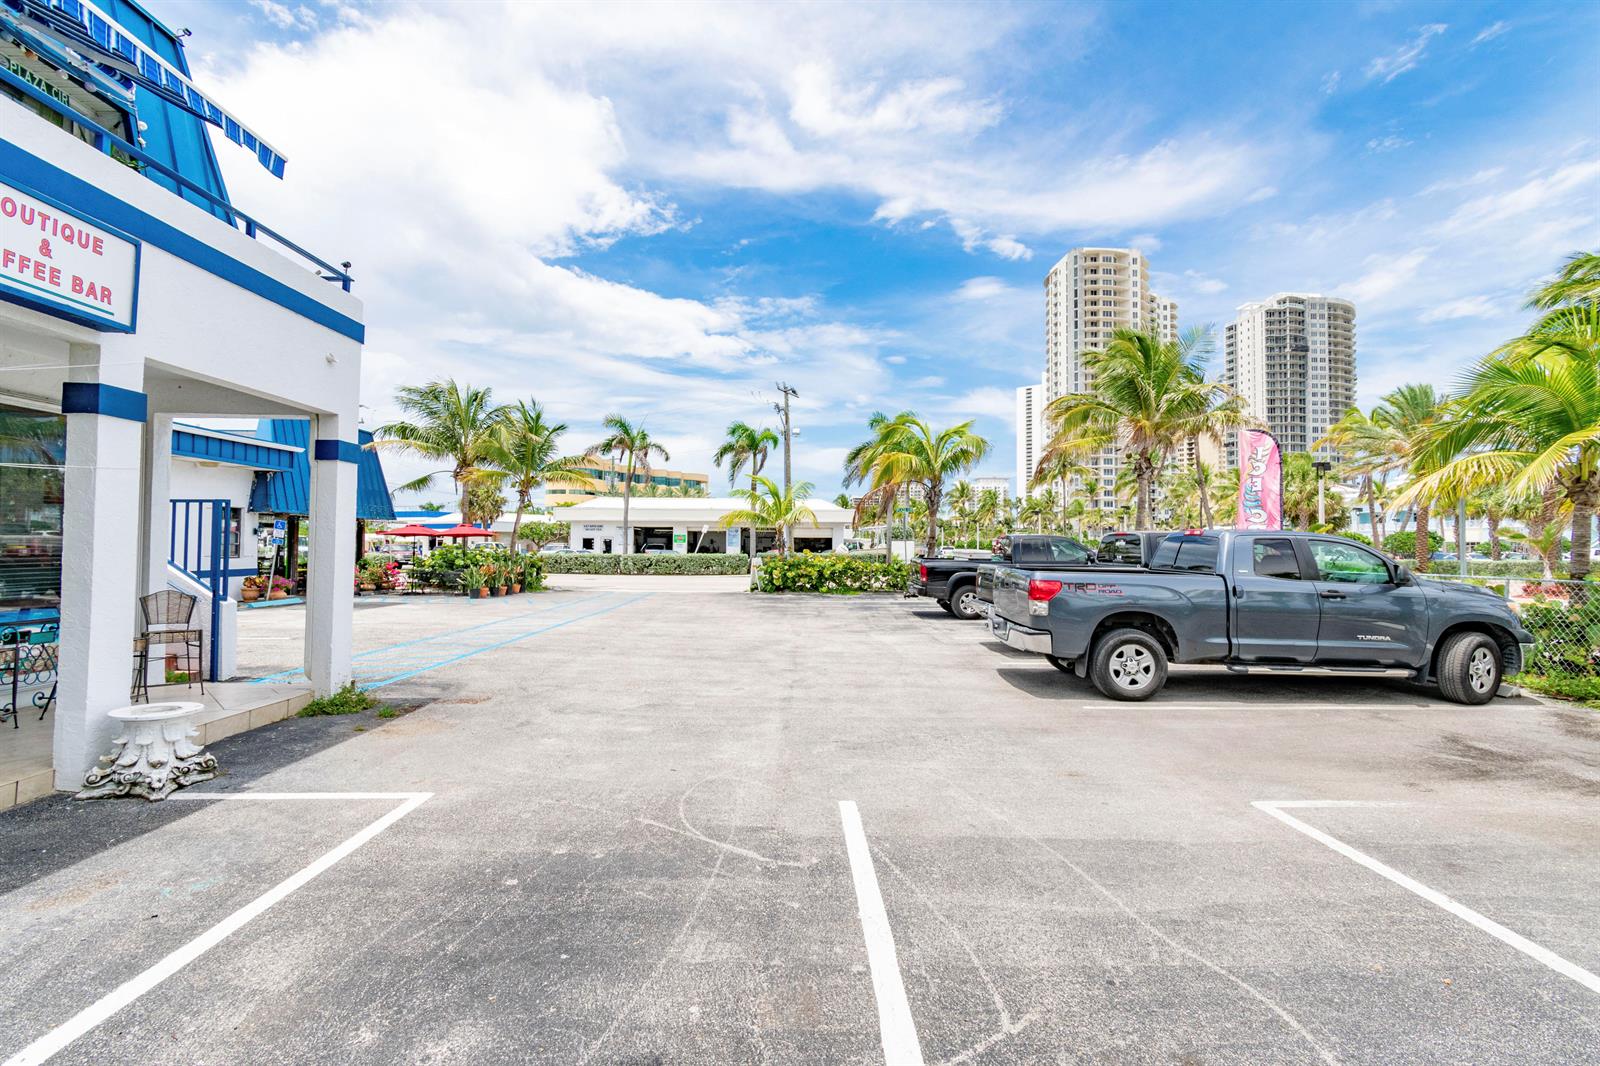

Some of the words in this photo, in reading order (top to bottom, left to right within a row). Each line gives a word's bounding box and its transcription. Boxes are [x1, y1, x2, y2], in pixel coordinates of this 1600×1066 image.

[39, 238, 53, 259] &
[71, 274, 112, 305] BAR
[1063, 582, 1097, 594] TRD
